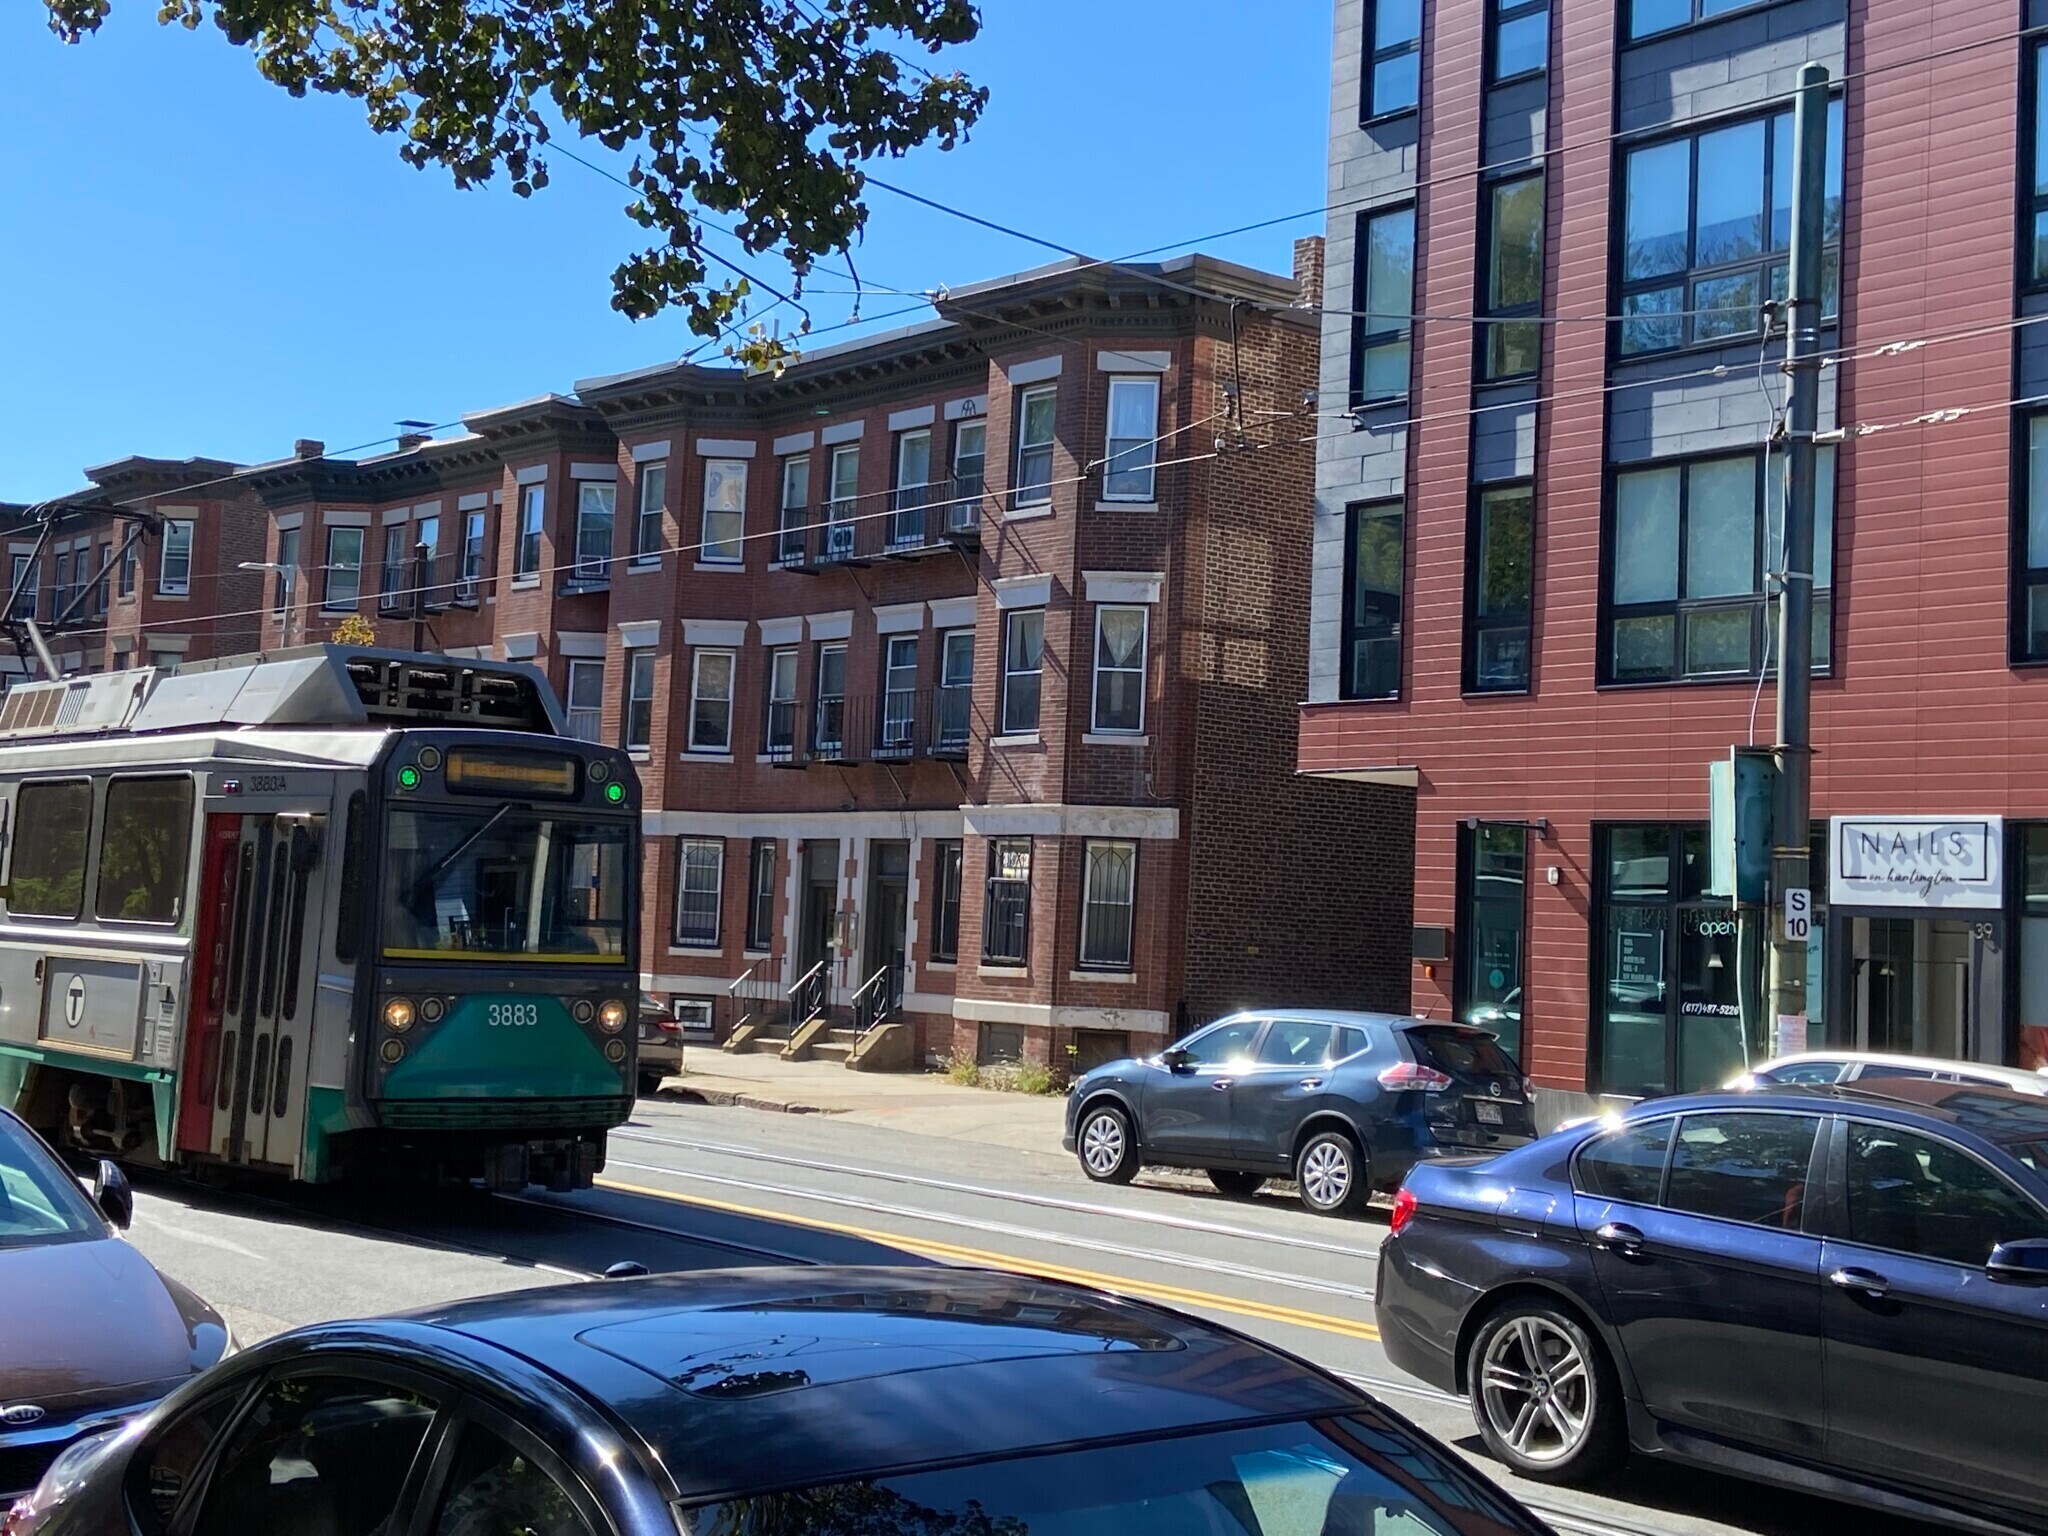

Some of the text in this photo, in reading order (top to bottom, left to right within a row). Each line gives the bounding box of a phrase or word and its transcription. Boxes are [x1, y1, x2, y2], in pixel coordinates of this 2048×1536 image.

[1861, 831, 1963, 856] NAILS
[1791, 892, 1806, 911] S
[1699, 921, 1737, 938] open
[1788, 918, 1808, 937] 10
[1974, 922, 1993, 940] 39
[488, 1004, 538, 1026] 3883
